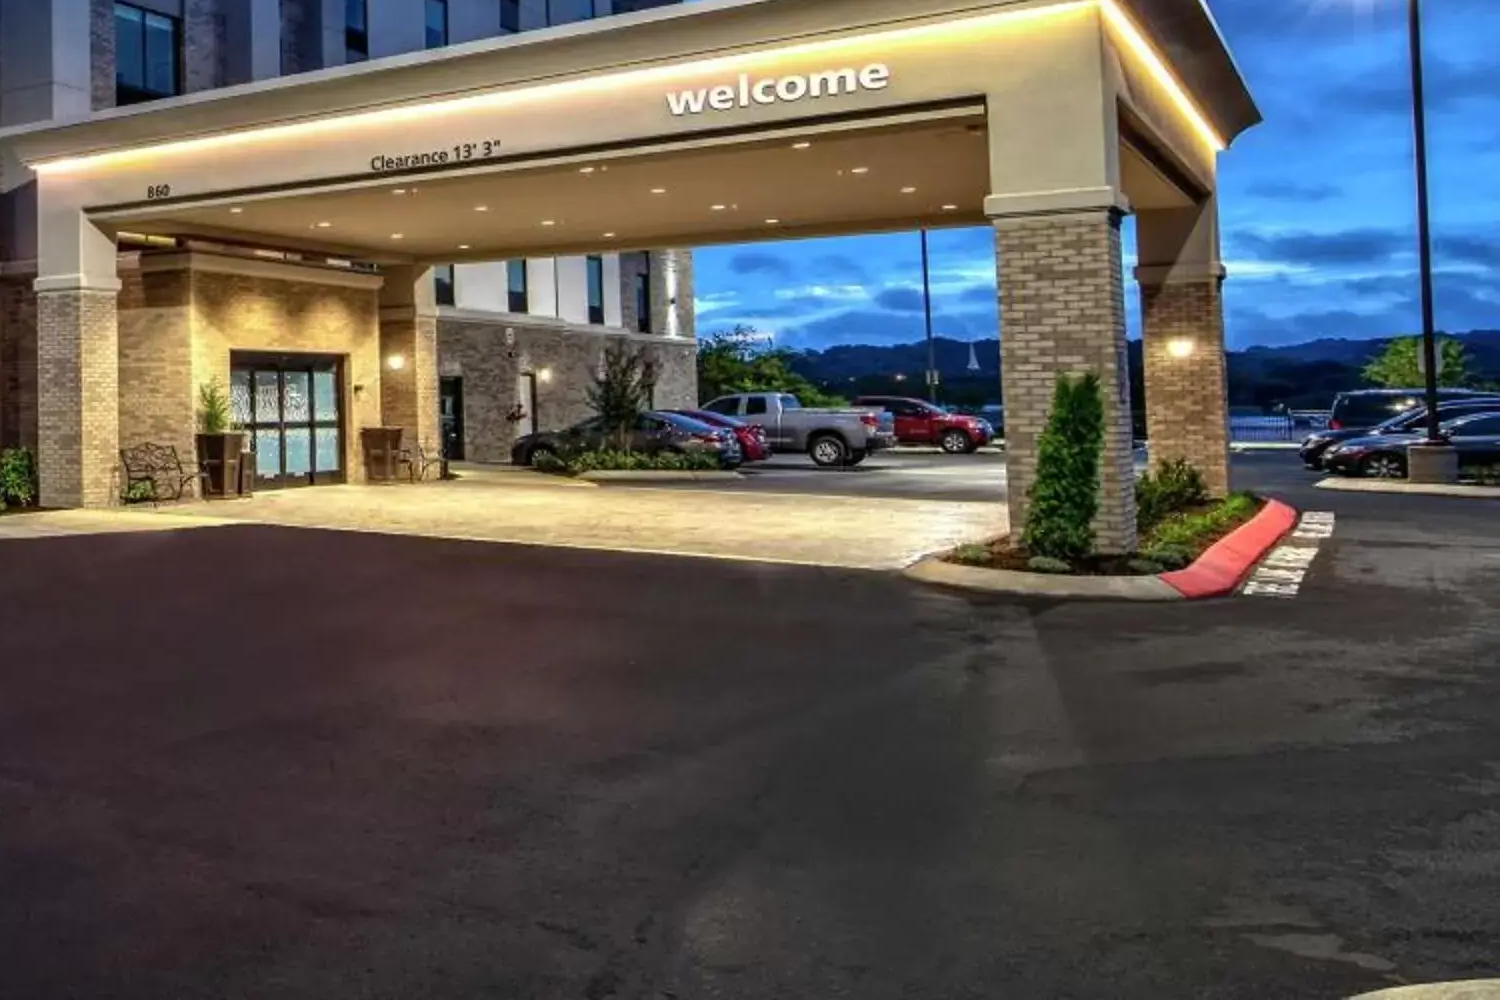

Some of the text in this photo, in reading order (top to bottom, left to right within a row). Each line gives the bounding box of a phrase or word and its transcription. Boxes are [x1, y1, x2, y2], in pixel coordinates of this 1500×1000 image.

[666, 62, 890, 116] welcome
[371, 139, 501, 173] Clearance 13' 3"
[147, 183, 171, 199] 860
